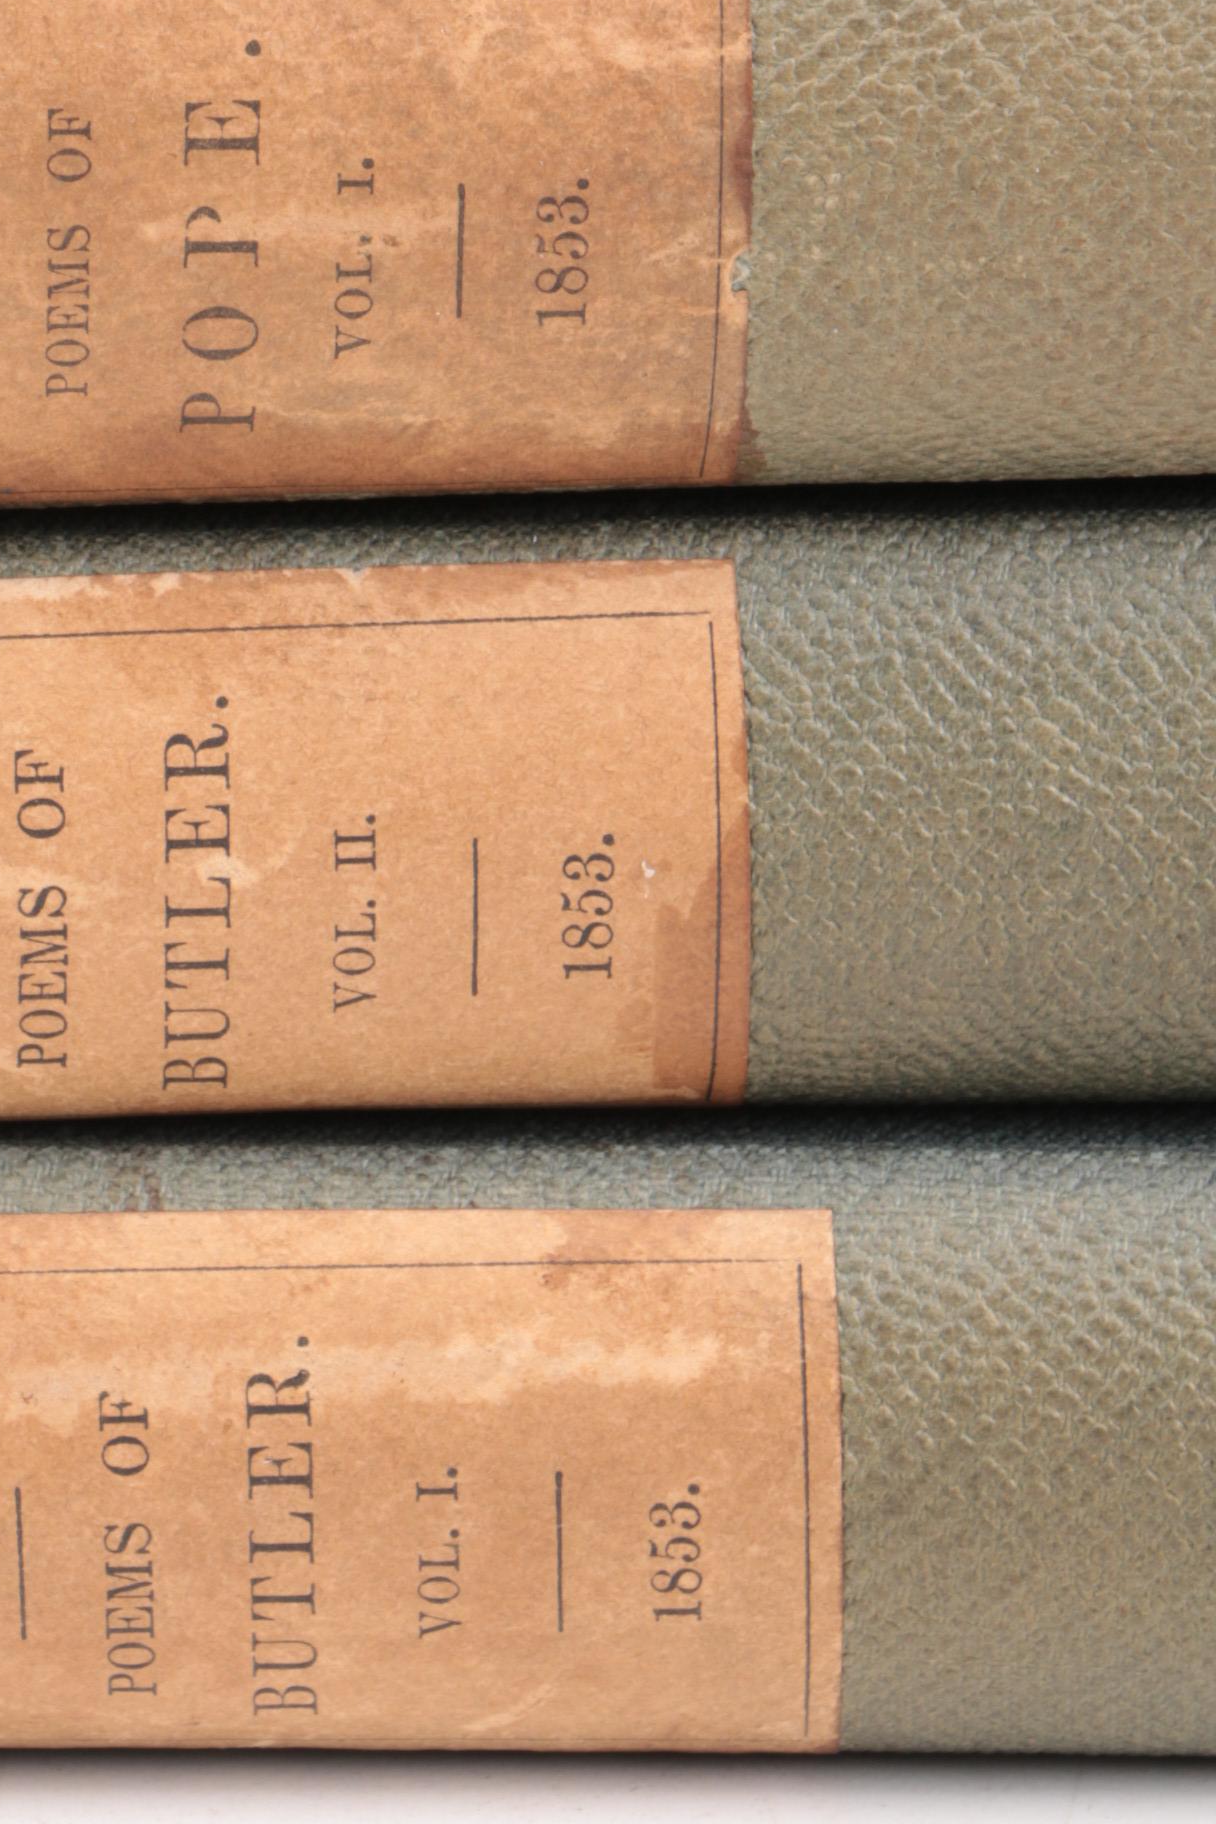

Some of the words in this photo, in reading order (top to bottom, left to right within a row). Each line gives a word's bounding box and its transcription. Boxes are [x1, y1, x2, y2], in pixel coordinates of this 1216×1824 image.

[47, 106, 93, 182] OF
[337, 157, 376, 195] I.
[179, 36, 262, 433] POPE.
[334, 234, 374, 359] VOL.
[534, 177, 591, 327] 1853.
[45, 225, 93, 397] POEMS
[12, 748, 67, 840] OF
[332, 813, 377, 870] II.
[160, 694, 233, 1090] BUTLER.
[333, 898, 378, 1013] VOL.
[562, 833, 616, 980] 1853.
[16, 884, 69, 1069] POEMS
[98, 1388, 151, 1477] OF
[415, 1466, 460, 1502] I.
[246, 1333, 320, 1716] BUTLER.
[417, 1526, 463, 1639] VOL.
[648, 1482, 703, 1623] 1853.
[105, 1522, 158, 1697] POEMS
